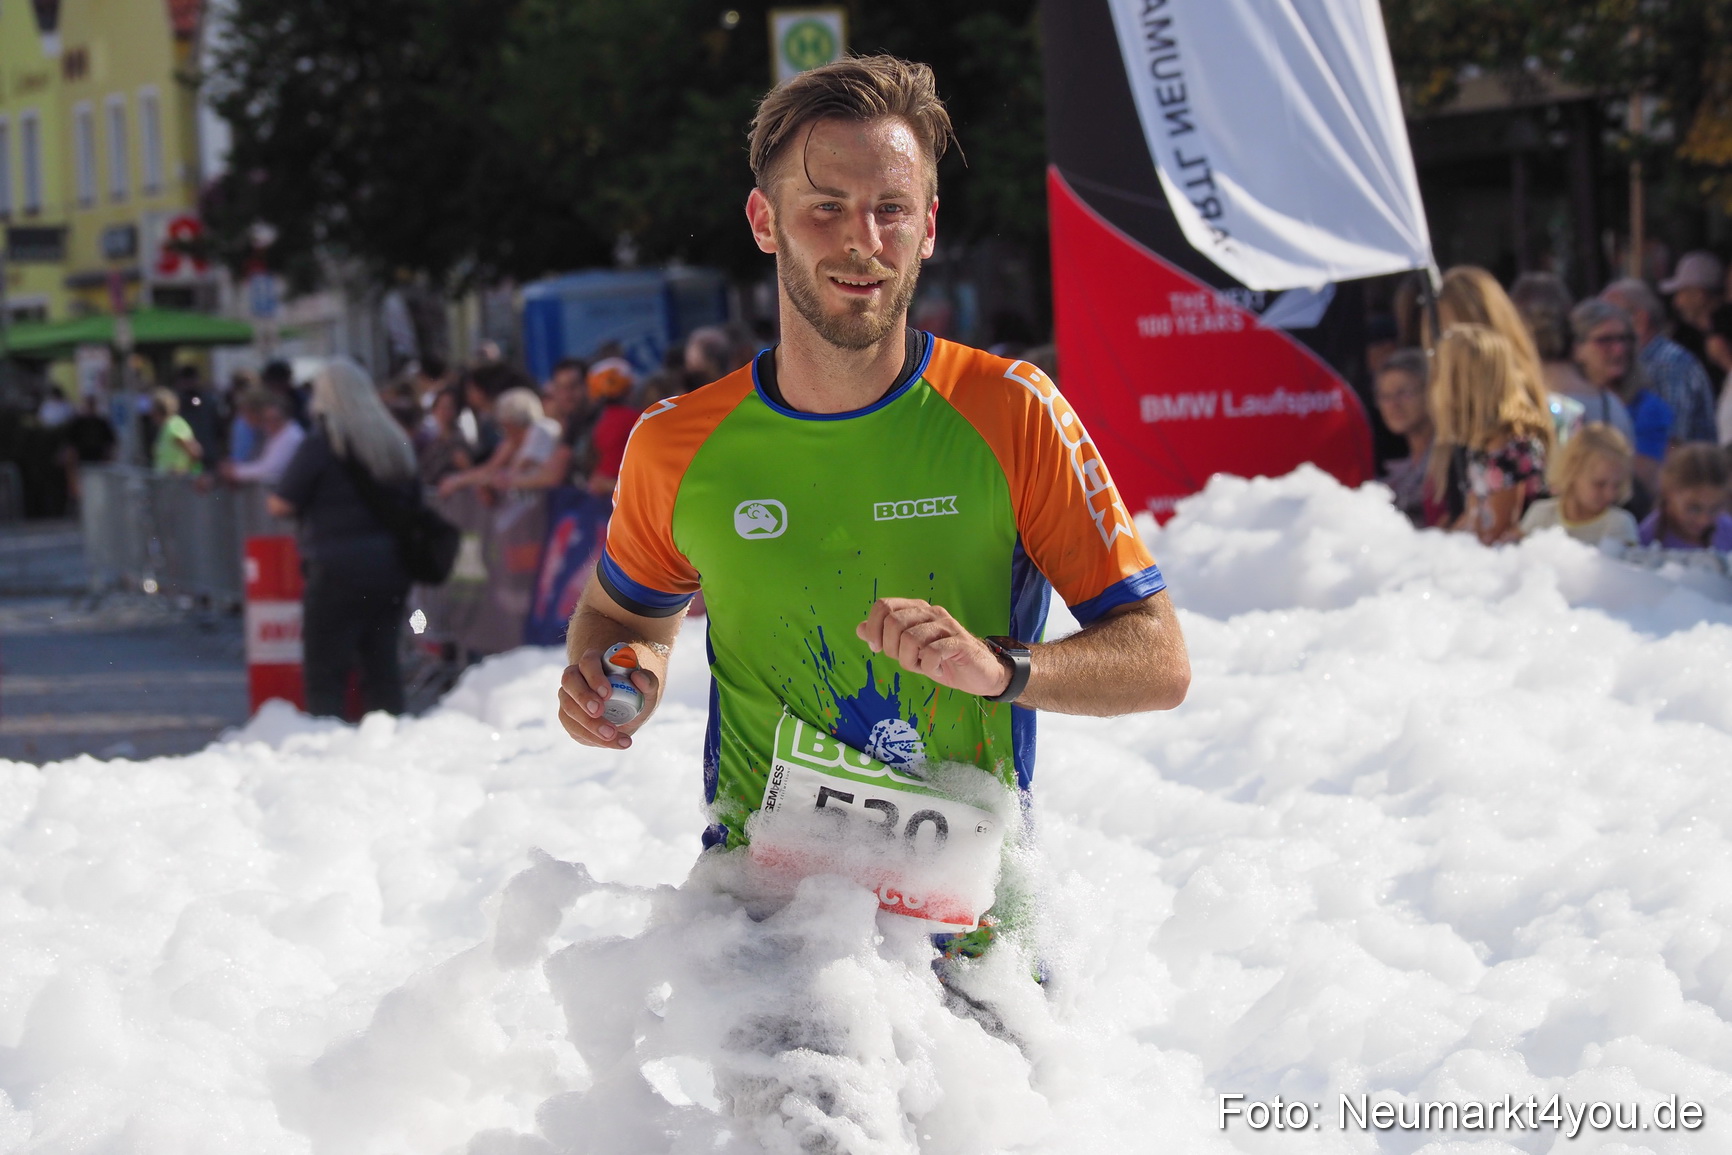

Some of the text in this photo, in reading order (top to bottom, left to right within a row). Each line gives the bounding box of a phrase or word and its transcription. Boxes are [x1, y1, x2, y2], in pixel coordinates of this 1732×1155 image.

[1169, 288, 1265, 313] THE NEXT
[1137, 312, 1243, 338] 100 YEARS
[1140, 387, 1344, 423] BMW Laufsport
[1003, 359, 1134, 554] BOCK
[873, 495, 960, 521] BOCK
